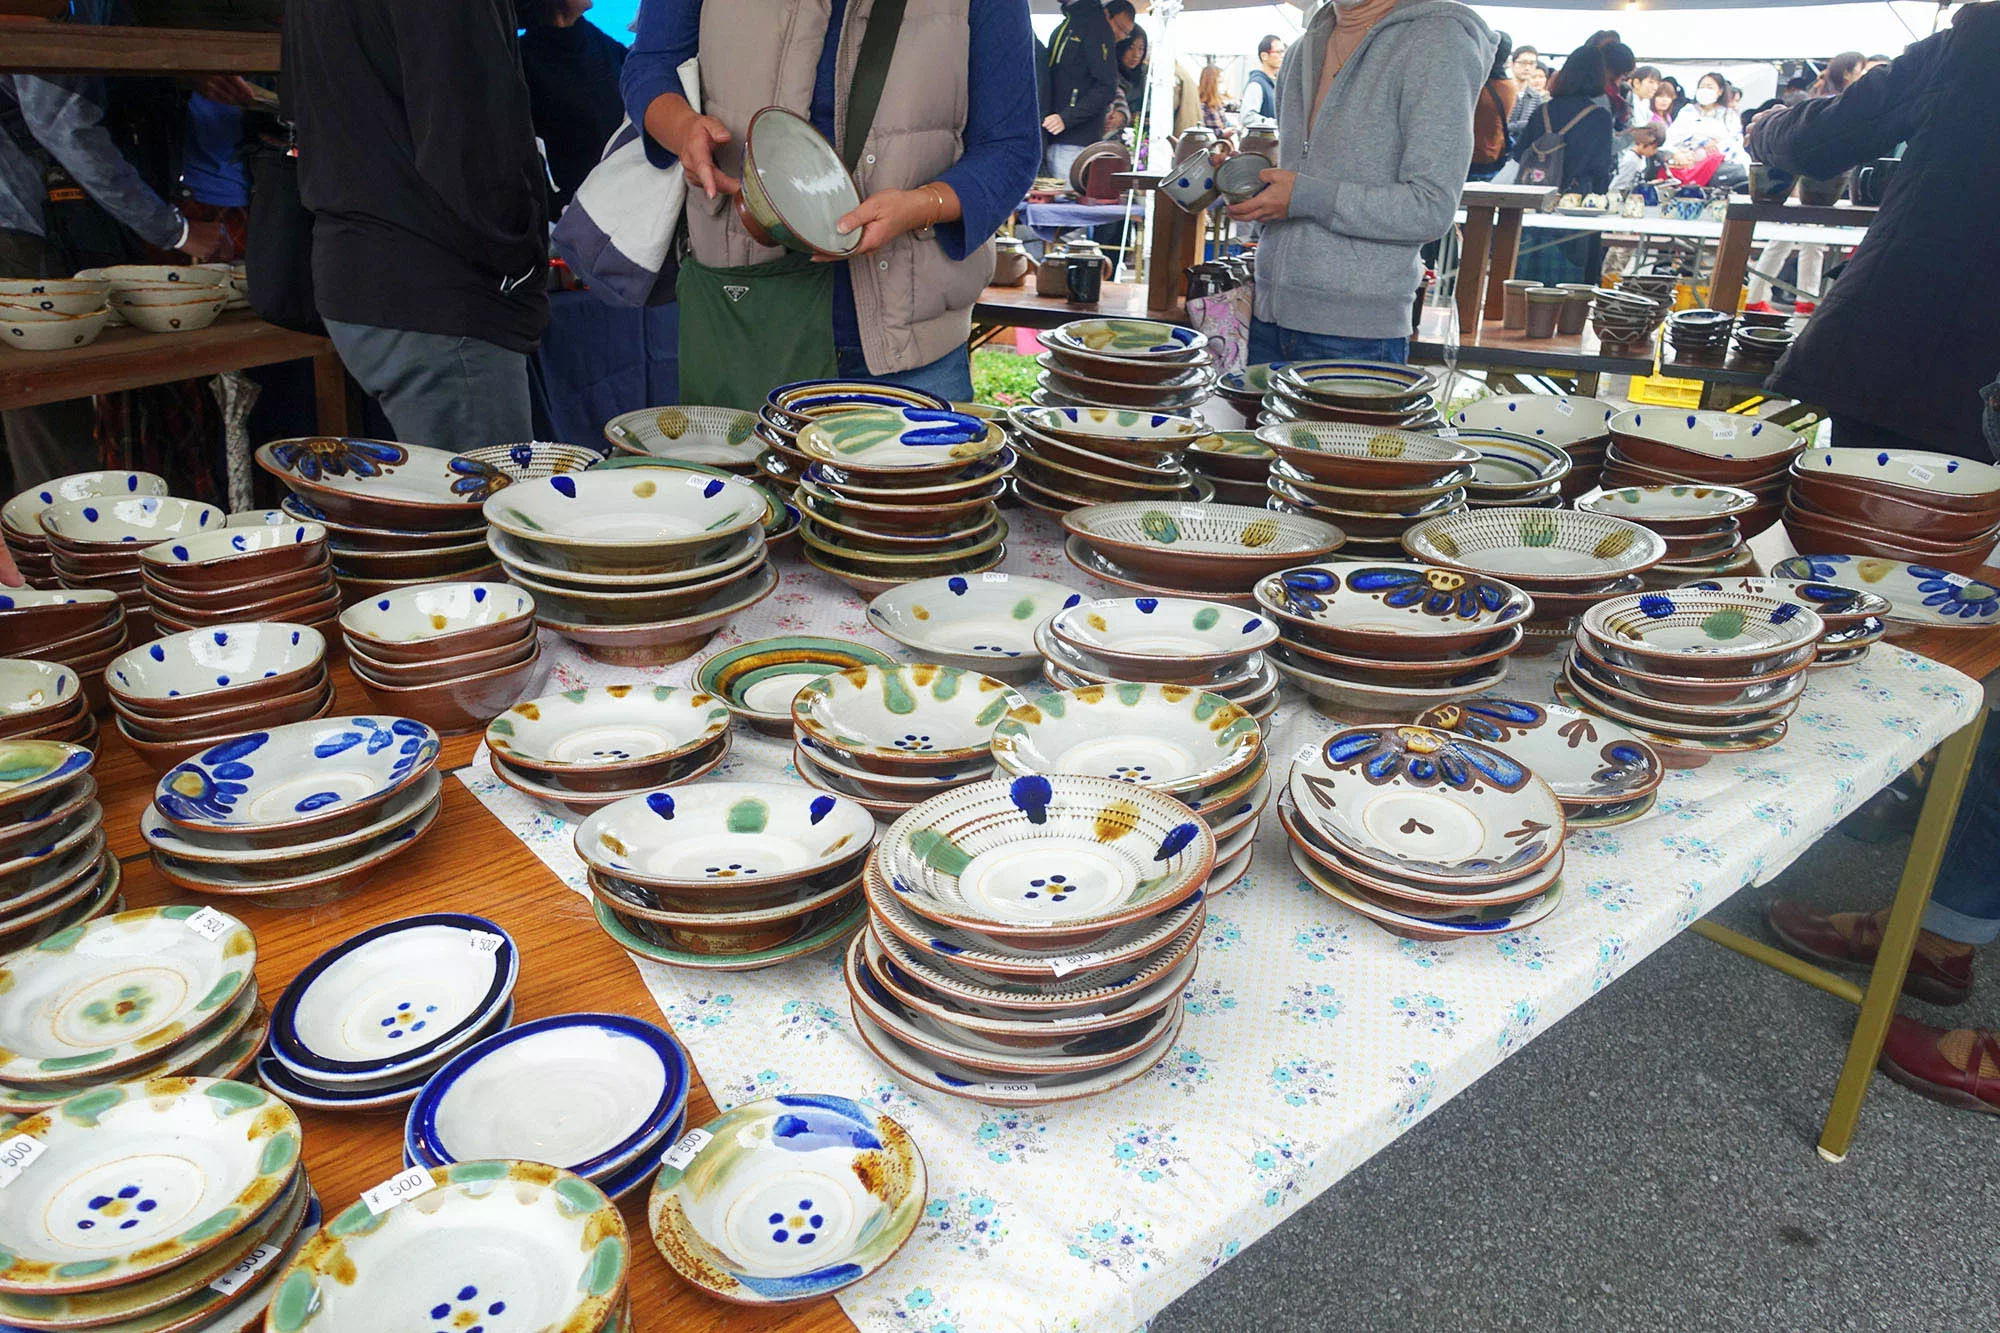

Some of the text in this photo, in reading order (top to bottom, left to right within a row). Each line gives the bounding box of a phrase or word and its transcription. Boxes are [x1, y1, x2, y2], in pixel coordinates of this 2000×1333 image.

[677, 1133, 702, 1153] 500
[388, 1174, 422, 1196] 500
[234, 1249, 266, 1273] 500
